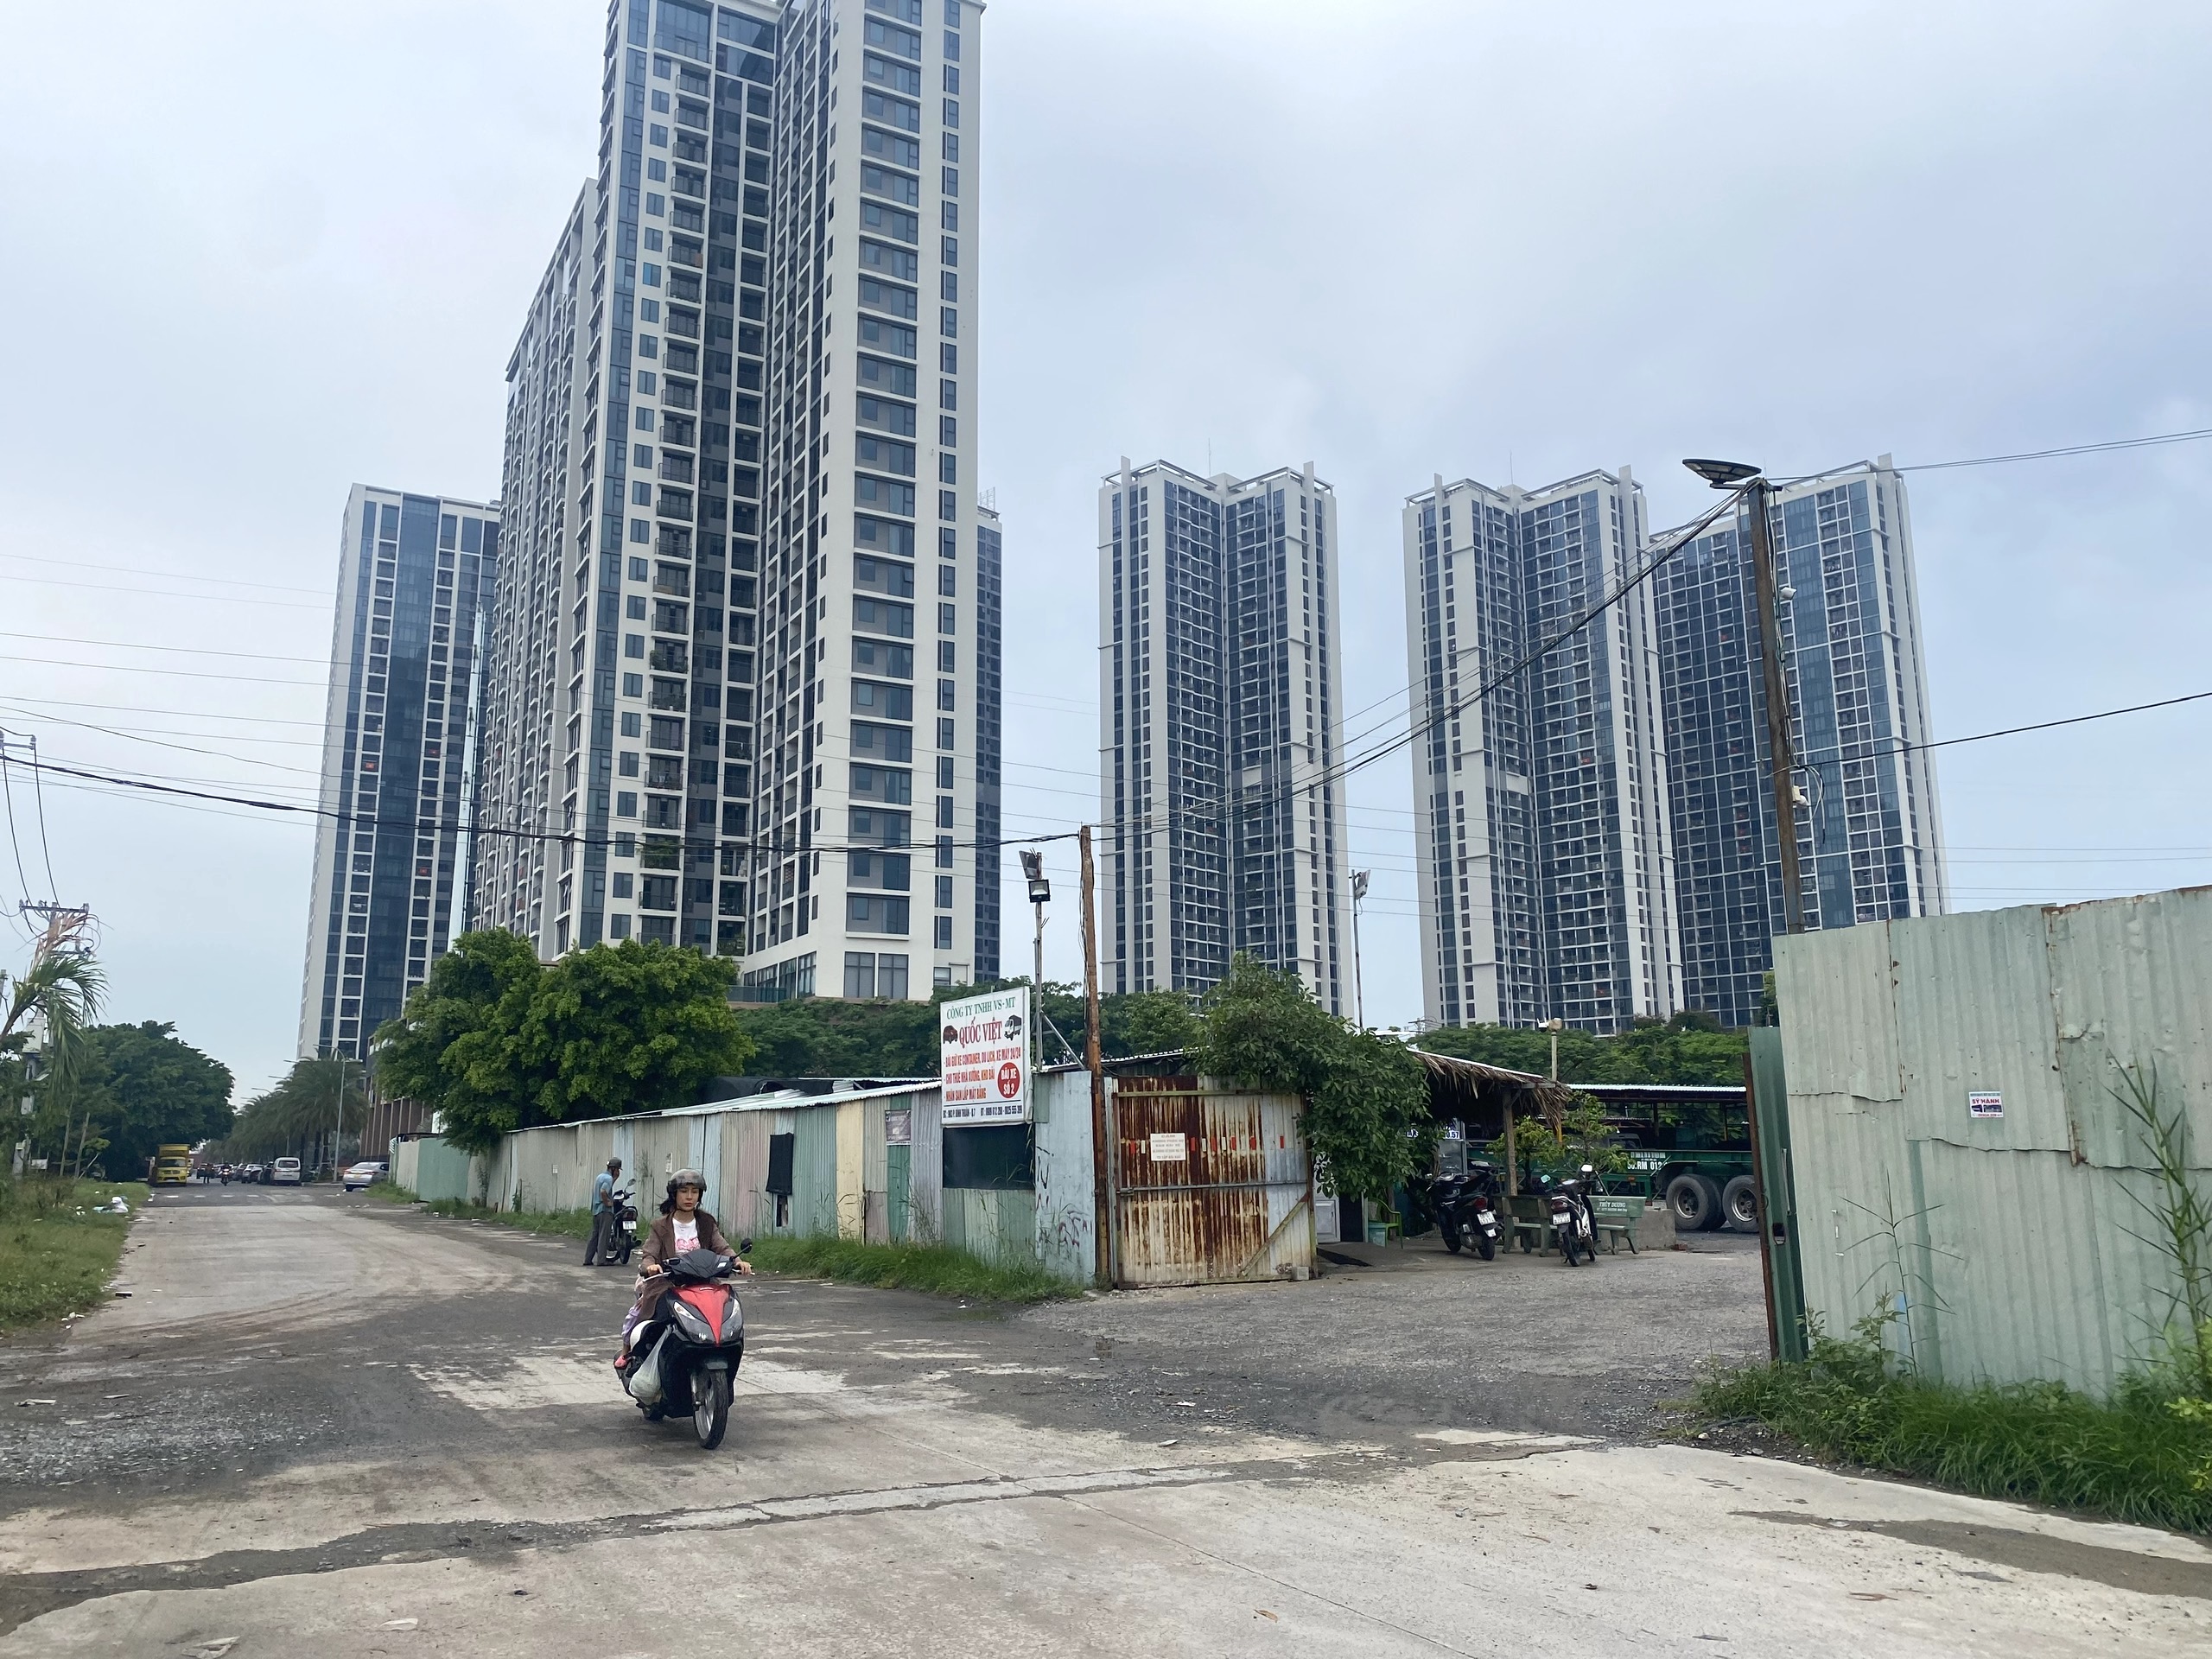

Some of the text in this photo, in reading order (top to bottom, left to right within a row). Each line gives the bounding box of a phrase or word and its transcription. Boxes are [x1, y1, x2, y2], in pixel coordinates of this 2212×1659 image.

[946, 1006, 963, 1020] CÔNG
[964, 1005, 973, 1016] TY
[974, 1001, 992, 1014] TNHH
[959, 1016, 1002, 1049] QUỐC VIỆT
[996, 1049, 1001, 1061] XE
[1001, 1067, 1017, 1080] BÃI XE
[1003, 1080, 1015, 1095] SỐ 2
